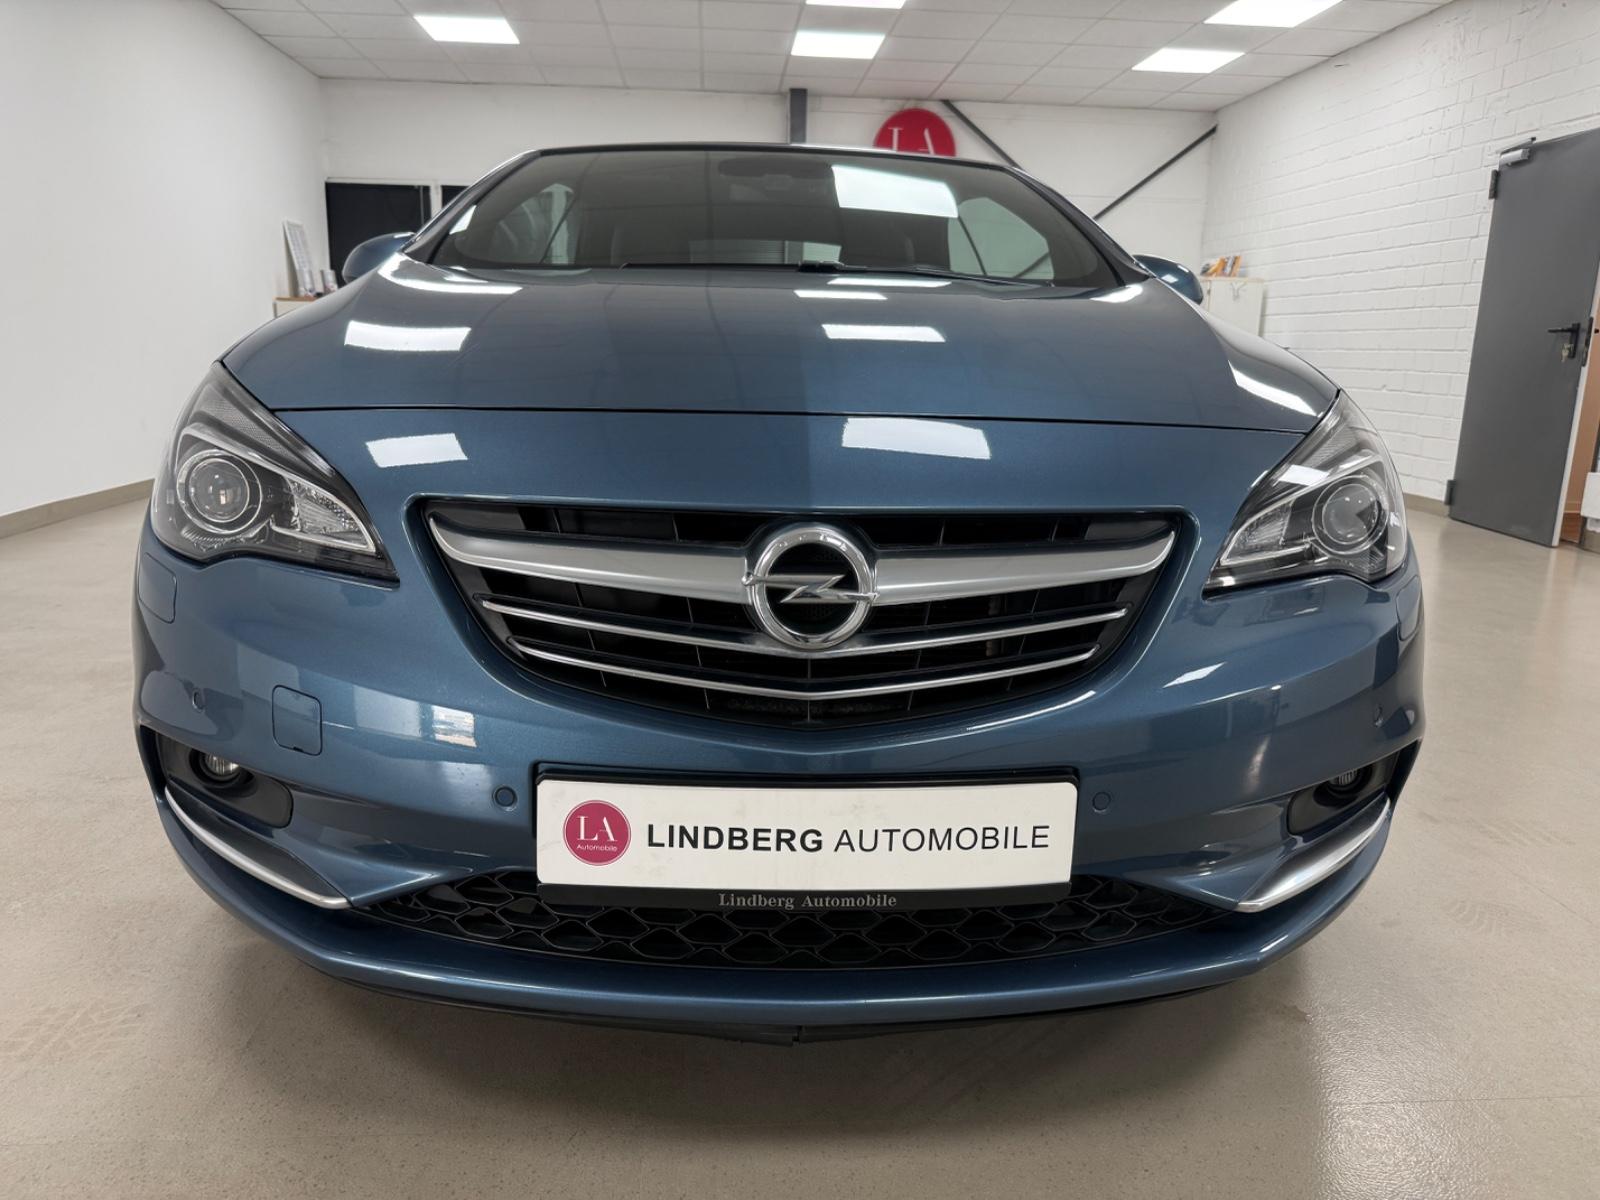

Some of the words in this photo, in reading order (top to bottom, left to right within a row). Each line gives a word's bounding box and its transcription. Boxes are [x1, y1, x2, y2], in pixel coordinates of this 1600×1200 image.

[576, 815, 618, 842] LA
[647, 823, 823, 853] LINDBERG
[833, 825, 1050, 853] AUTOMOBILE
[576, 844, 618, 852] Automobile
[718, 893, 795, 910] Lindberg
[801, 894, 897, 908] Automobile
